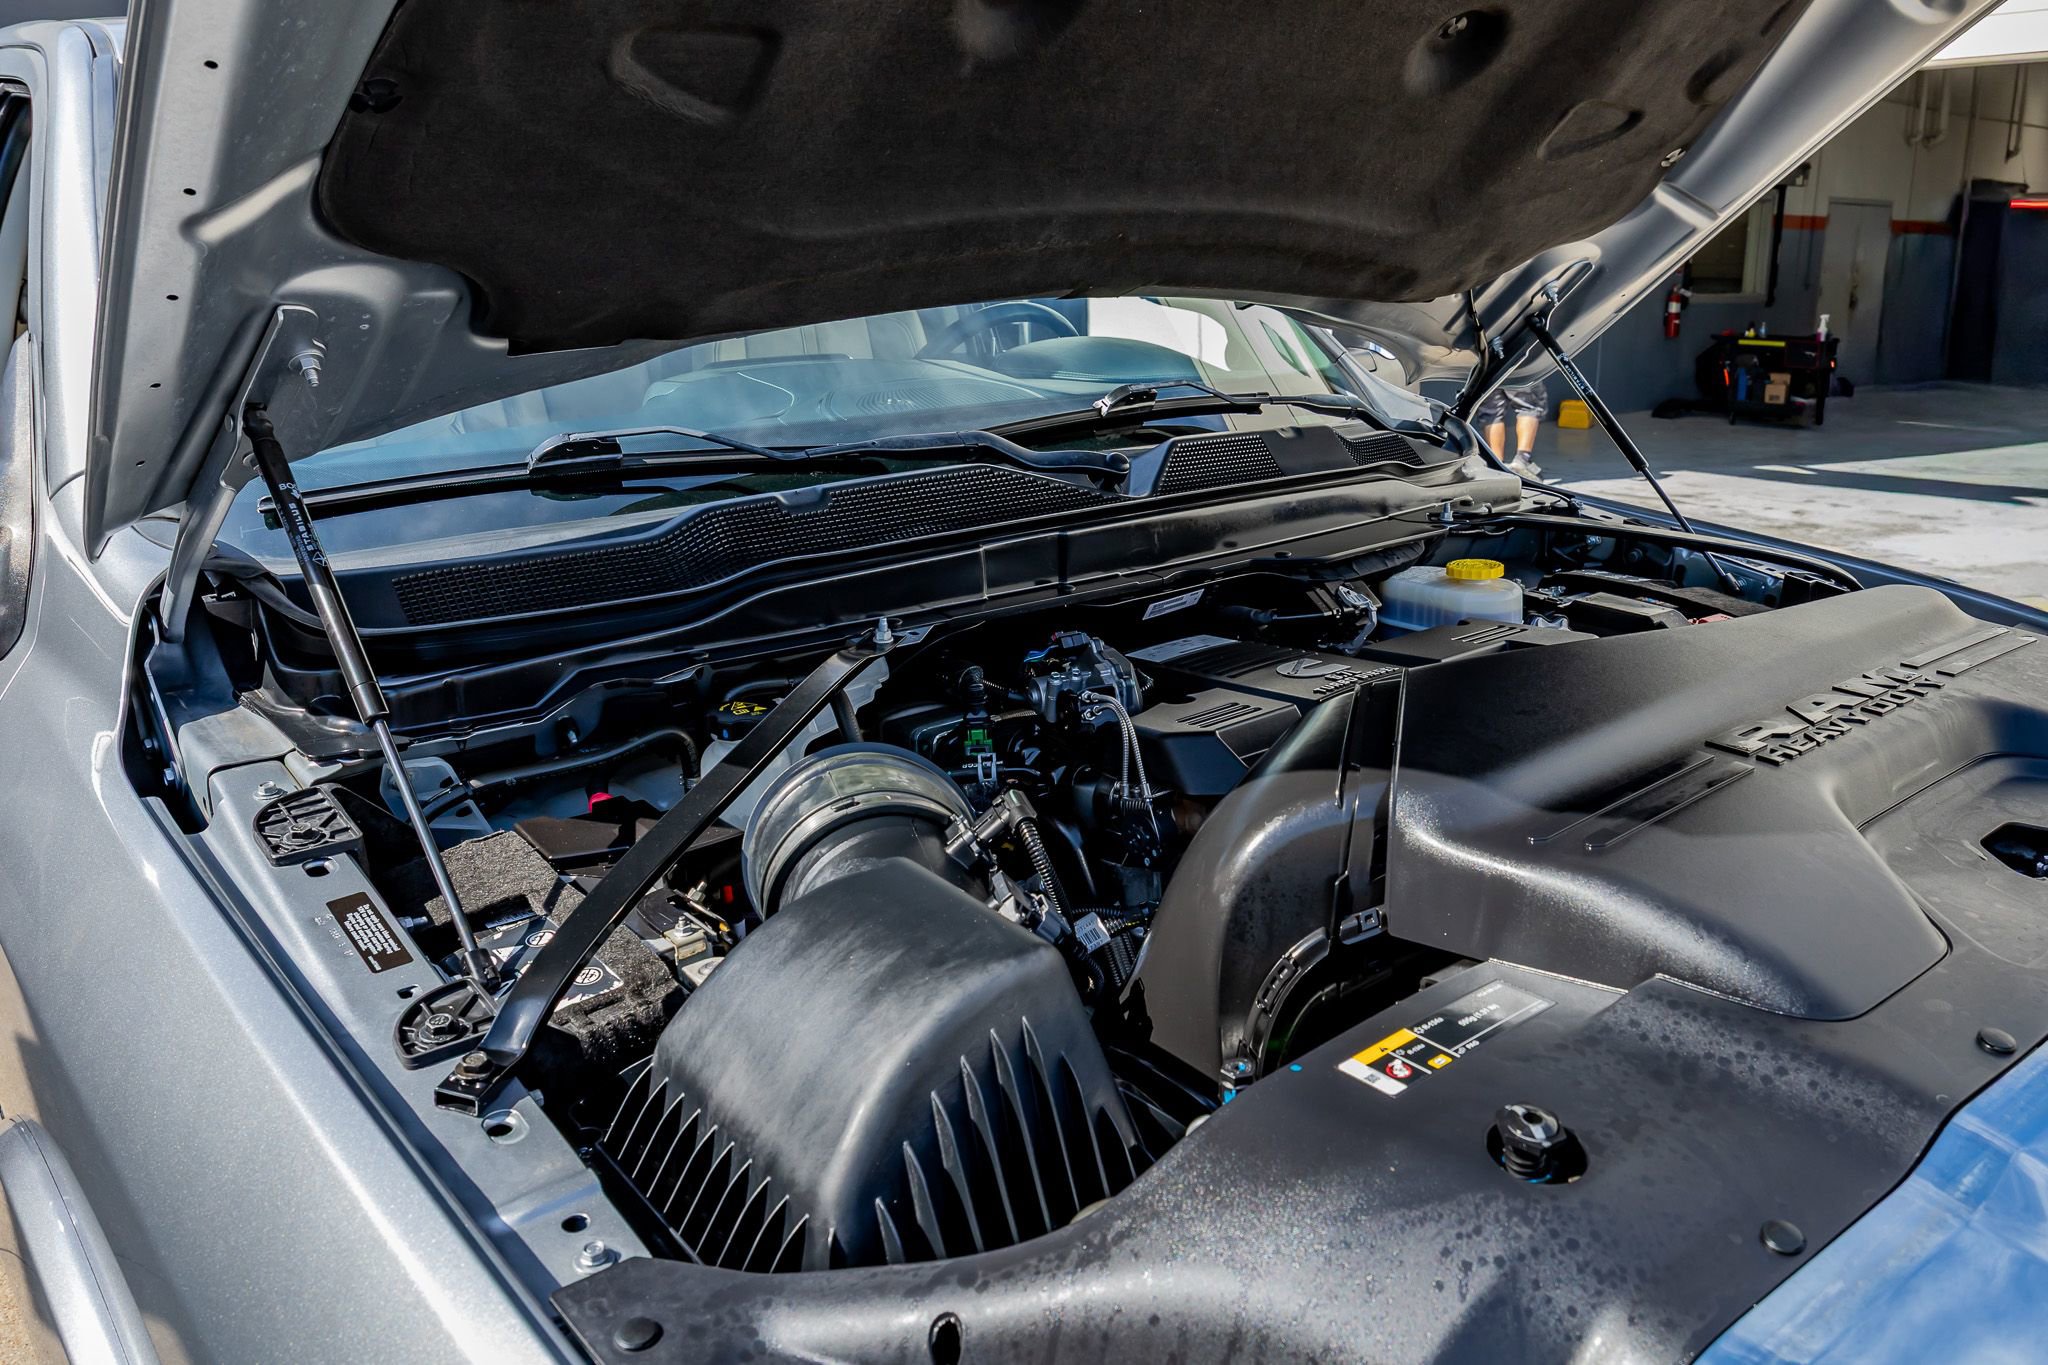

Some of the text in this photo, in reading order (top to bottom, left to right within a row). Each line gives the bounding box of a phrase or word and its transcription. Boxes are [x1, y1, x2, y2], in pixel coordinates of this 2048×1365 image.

[288, 502, 314, 552] STABILUS
[1313, 677, 1358, 694] TURBO
[1705, 666, 1924, 758] RAM
[1756, 677, 1946, 767] HEAVY DUTY
